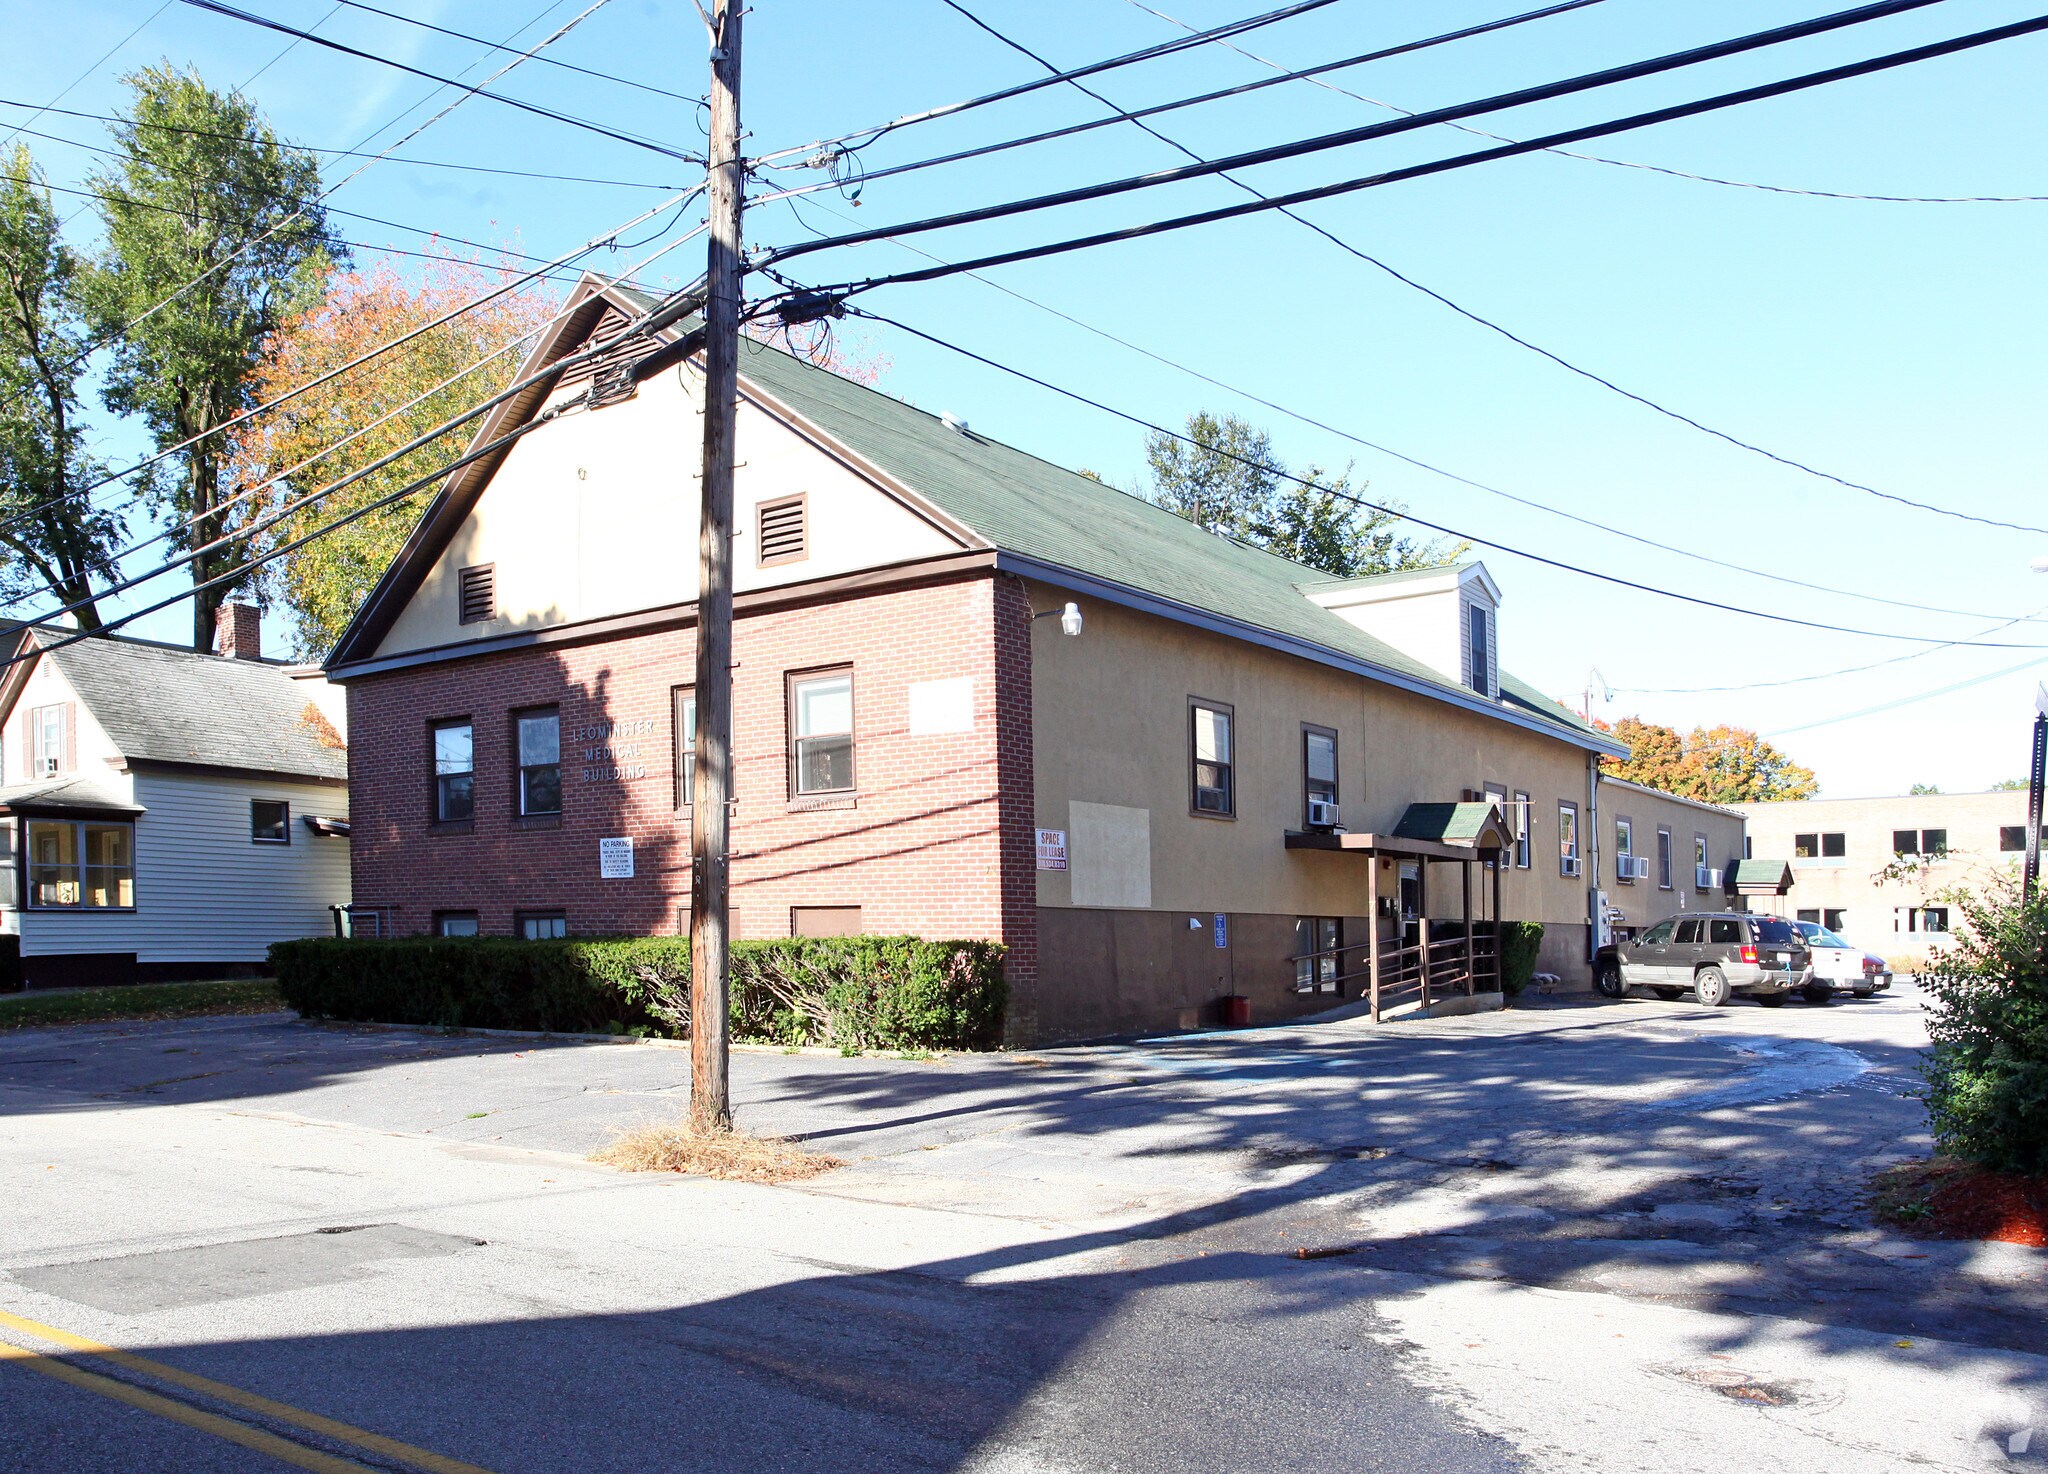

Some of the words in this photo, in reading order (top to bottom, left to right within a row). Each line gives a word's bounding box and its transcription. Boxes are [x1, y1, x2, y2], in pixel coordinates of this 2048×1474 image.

[573, 720, 653, 741] LEOMINSTER
[585, 743, 642, 760] MEDICAL
[583, 764, 646, 782] BUILDING
[1041, 832, 1060, 846] SPACE
[1038, 846, 1048, 857] FOR
[1048, 847, 1065, 858] LEASE
